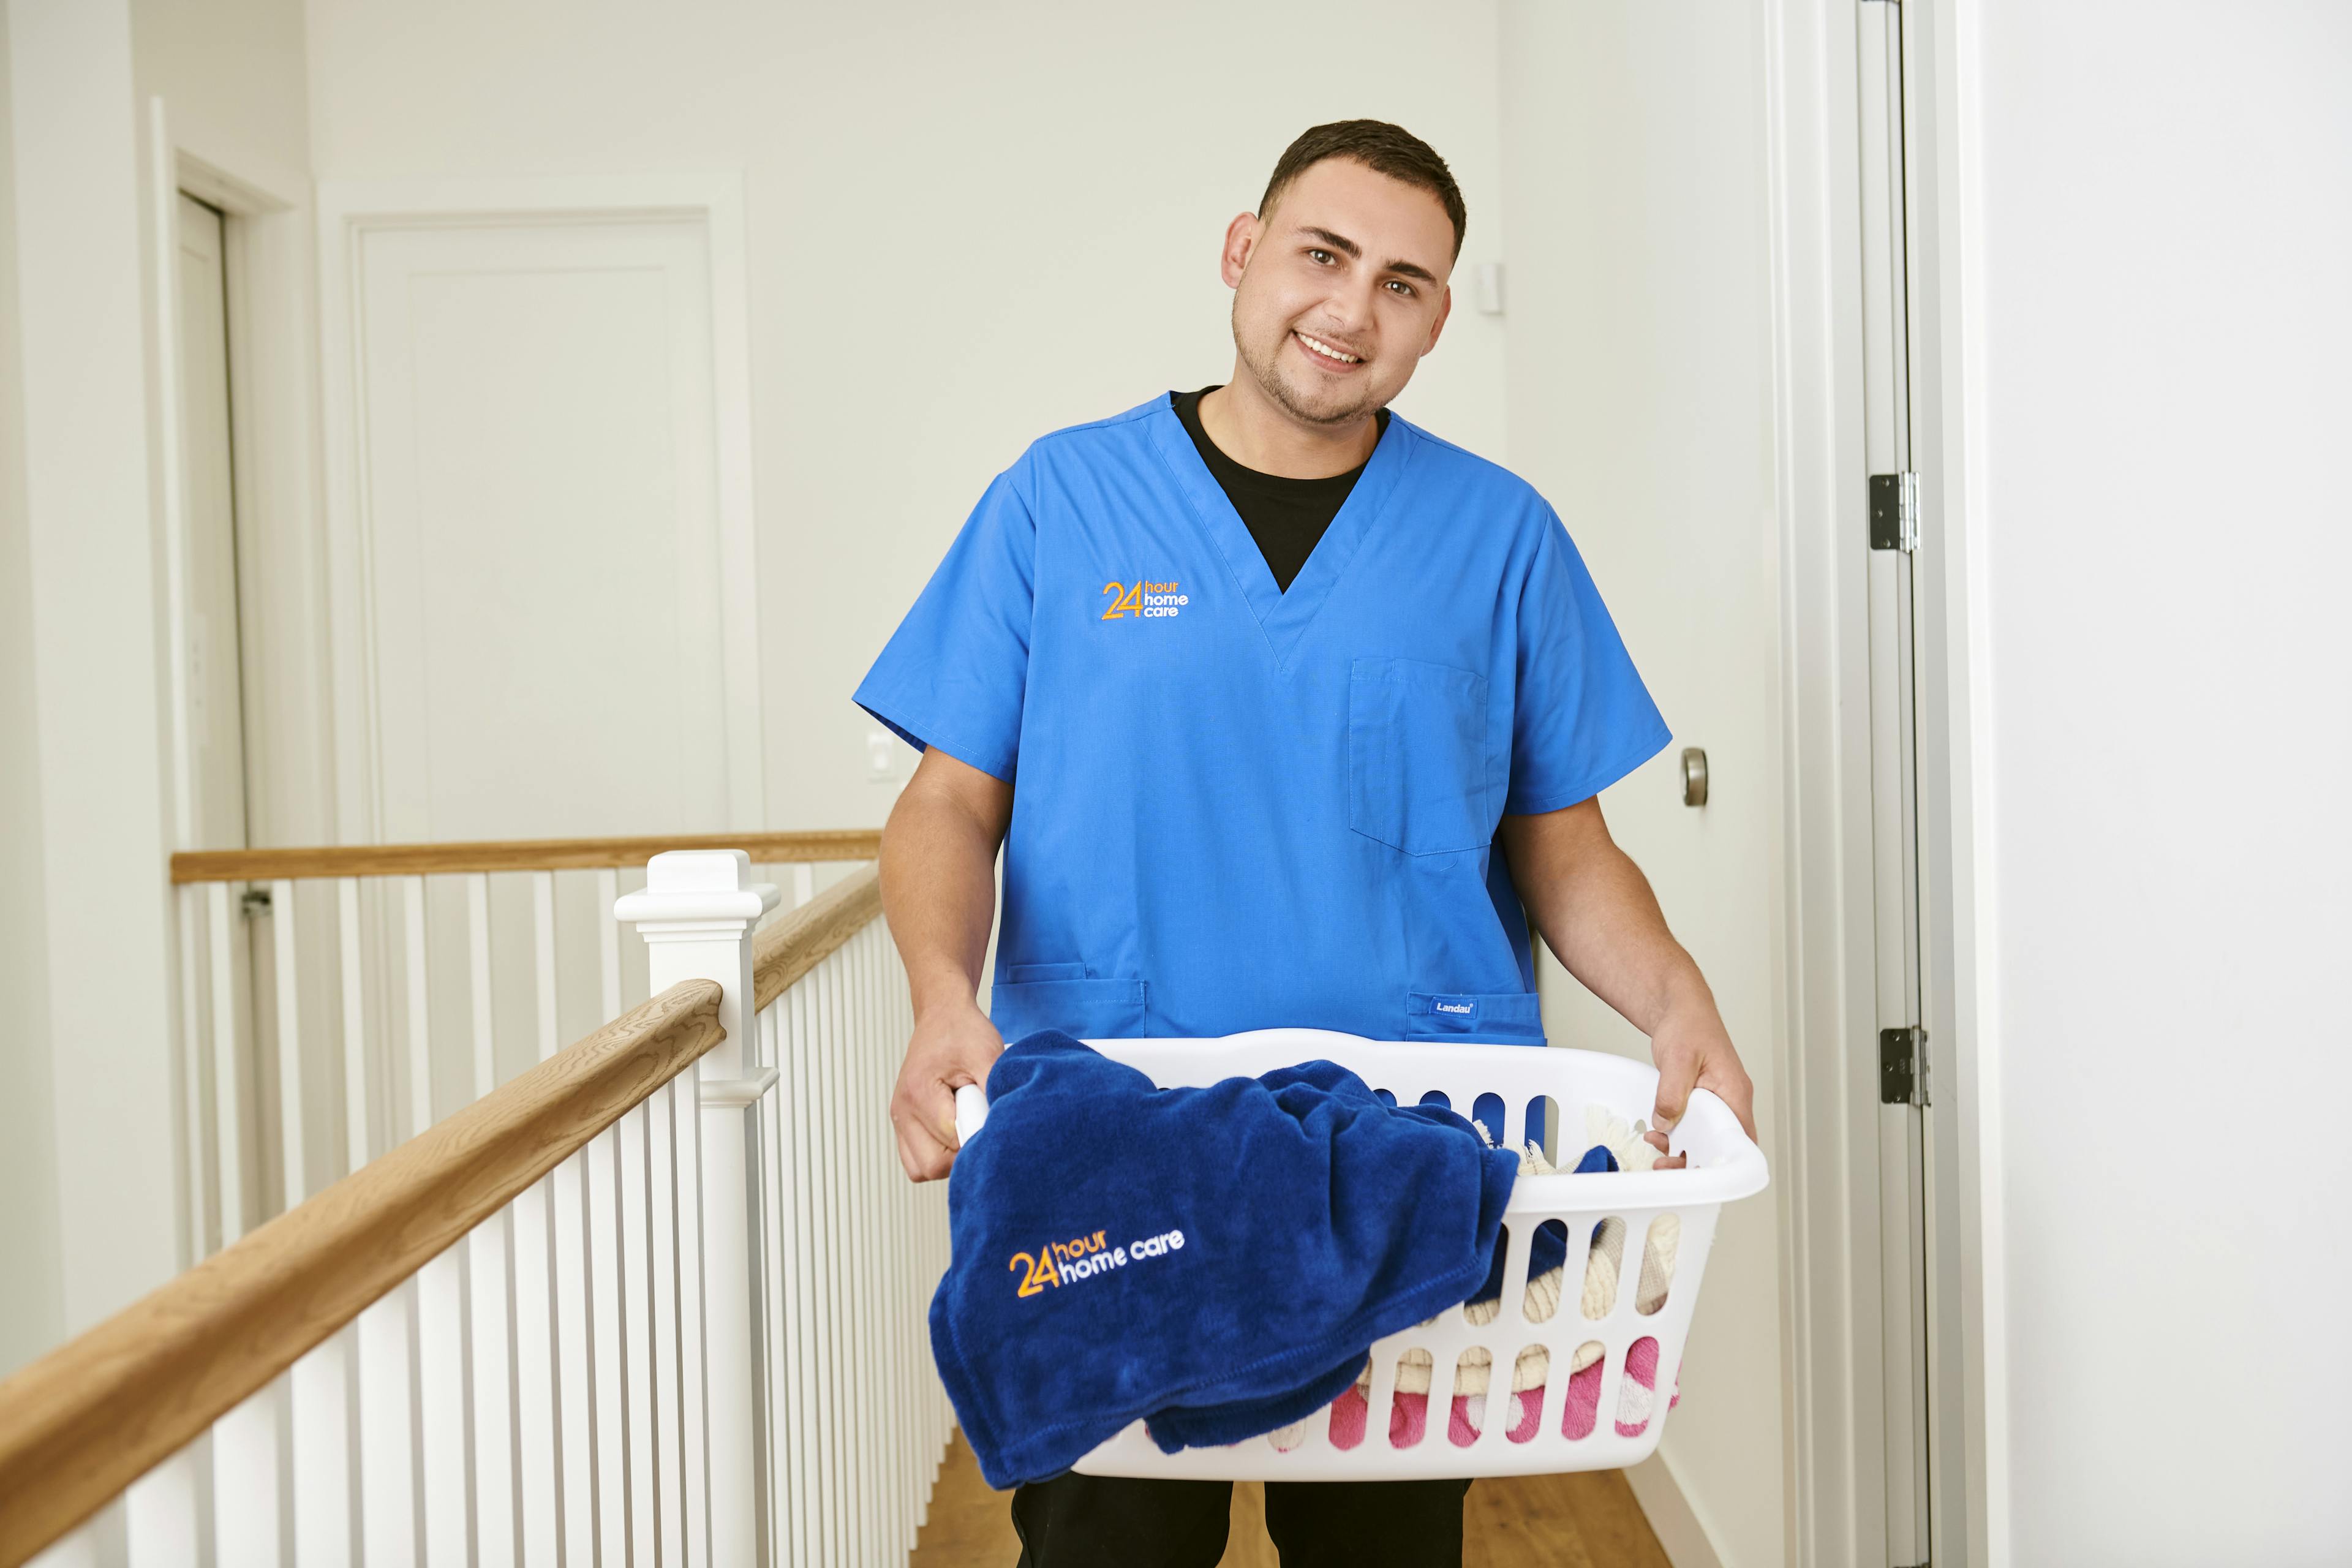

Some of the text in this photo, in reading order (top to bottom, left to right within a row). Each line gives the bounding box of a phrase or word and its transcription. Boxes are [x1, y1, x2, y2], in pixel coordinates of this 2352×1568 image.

[1101, 580, 1178, 620] 24 hour
[1144, 594, 1189, 605] home
[1144, 607, 1178, 617] care
[1009, 1230, 1106, 1298] 24 hour
[1058, 1229, 1185, 1284] home care
